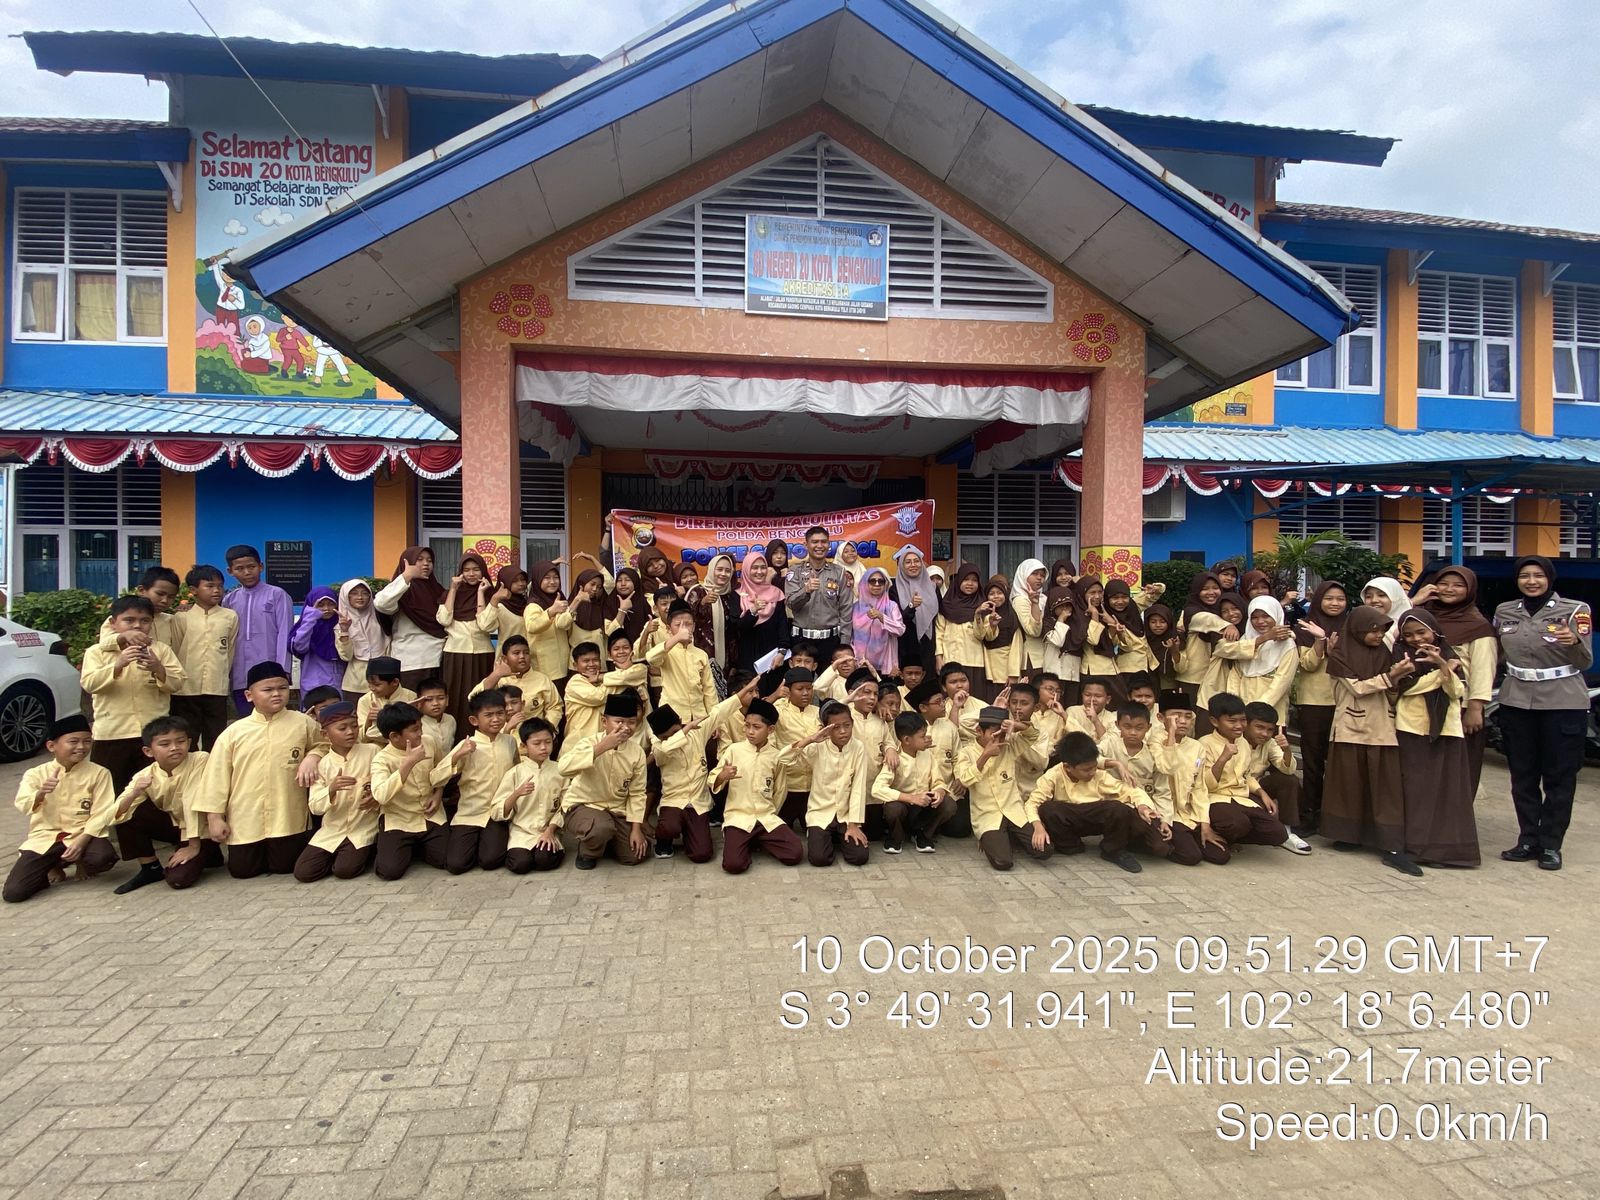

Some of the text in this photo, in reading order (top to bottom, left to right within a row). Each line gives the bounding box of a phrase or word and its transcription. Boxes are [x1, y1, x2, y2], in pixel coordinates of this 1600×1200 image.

[202, 131, 373, 174] Selamat Datang
[200, 160, 360, 183] Di SDN 20 KOTA BENGKULU
[208, 179, 261, 195] Semangat
[264, 180, 305, 196] Belajar
[305, 184, 320, 195] dan
[234, 194, 323, 208] Di Sekolah SDN
[766, 251, 798, 280] NEGERI
[799, 252, 809, 281] 20
[811, 254, 833, 282] KOTA
[837, 255, 882, 286] BENGKULU
[783, 280, 837, 298] AKREDITASI
[674, 515, 781, 530] DIREKTORAT
[782, 515, 823, 528] LALU
[823, 509, 881, 526] LINTAS
[717, 525, 844, 541] POLDA BENGLU
[283, 542, 304, 551] BNI
[681, 544, 749, 566] POLCE
